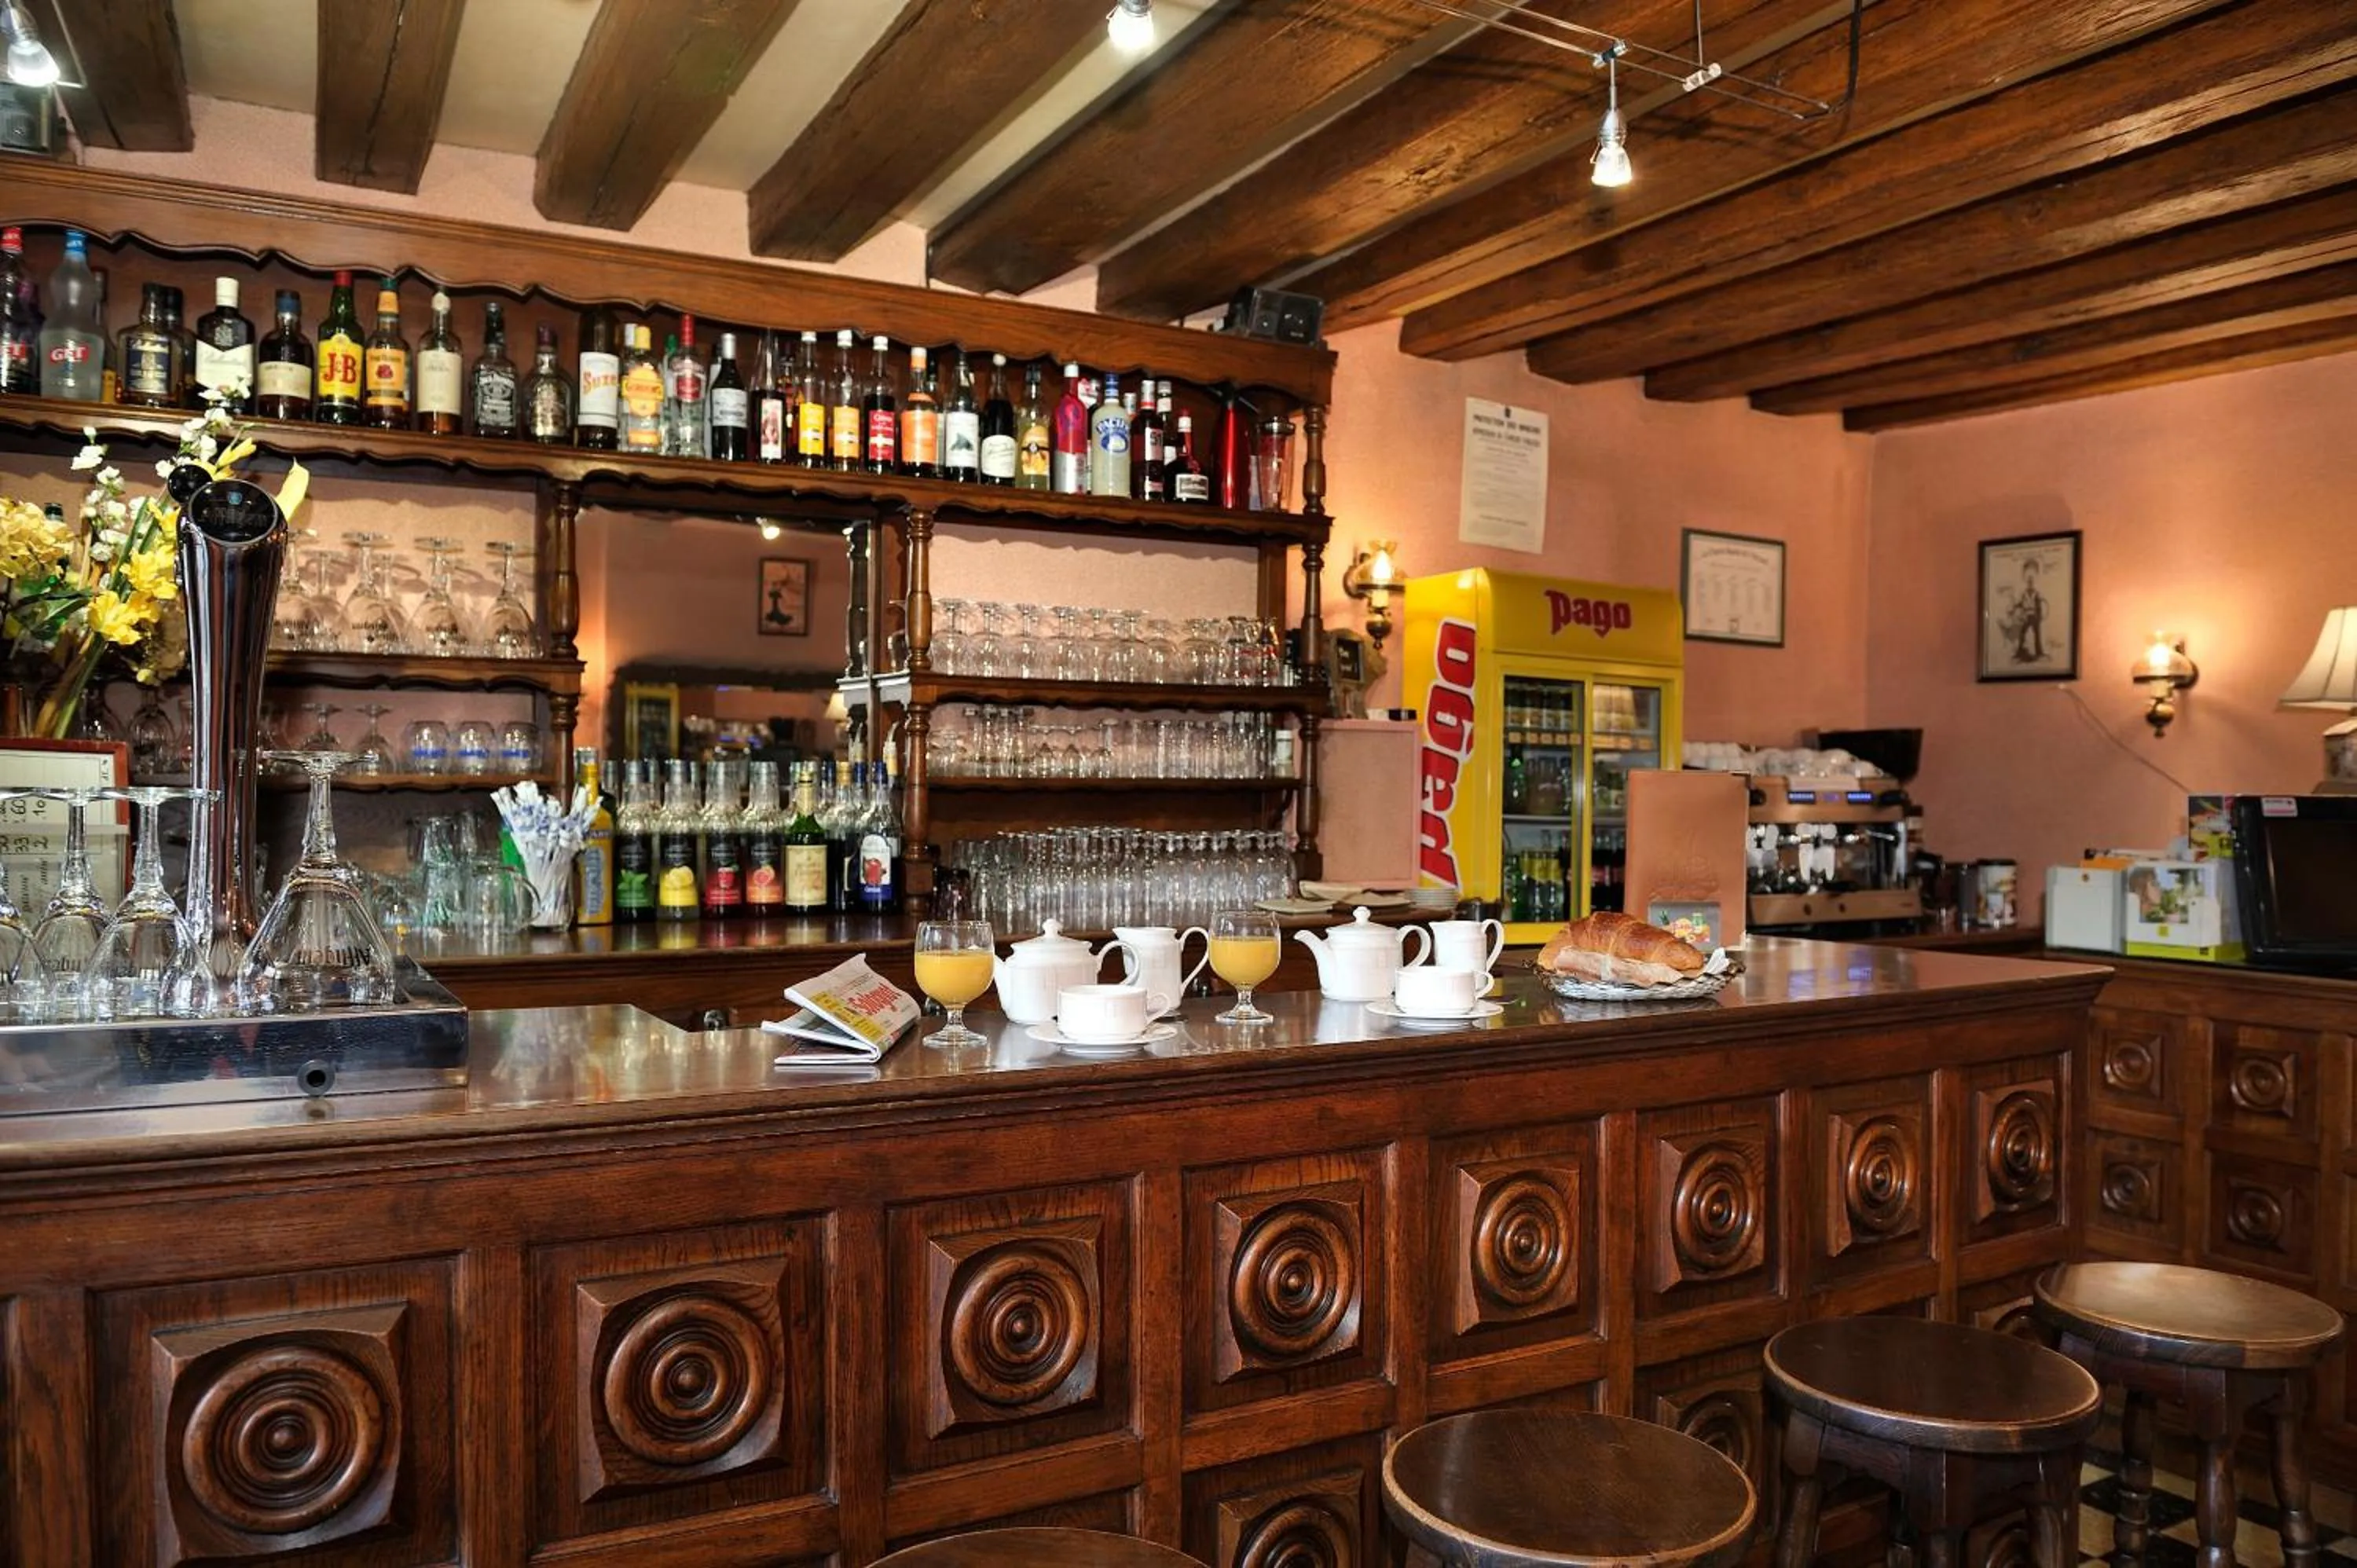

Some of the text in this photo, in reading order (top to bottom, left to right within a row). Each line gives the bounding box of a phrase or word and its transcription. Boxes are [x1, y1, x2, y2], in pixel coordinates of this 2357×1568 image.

[51, 347, 88, 361] GET
[1545, 590, 1632, 639] pago
[1420, 620, 1476, 889] pago
